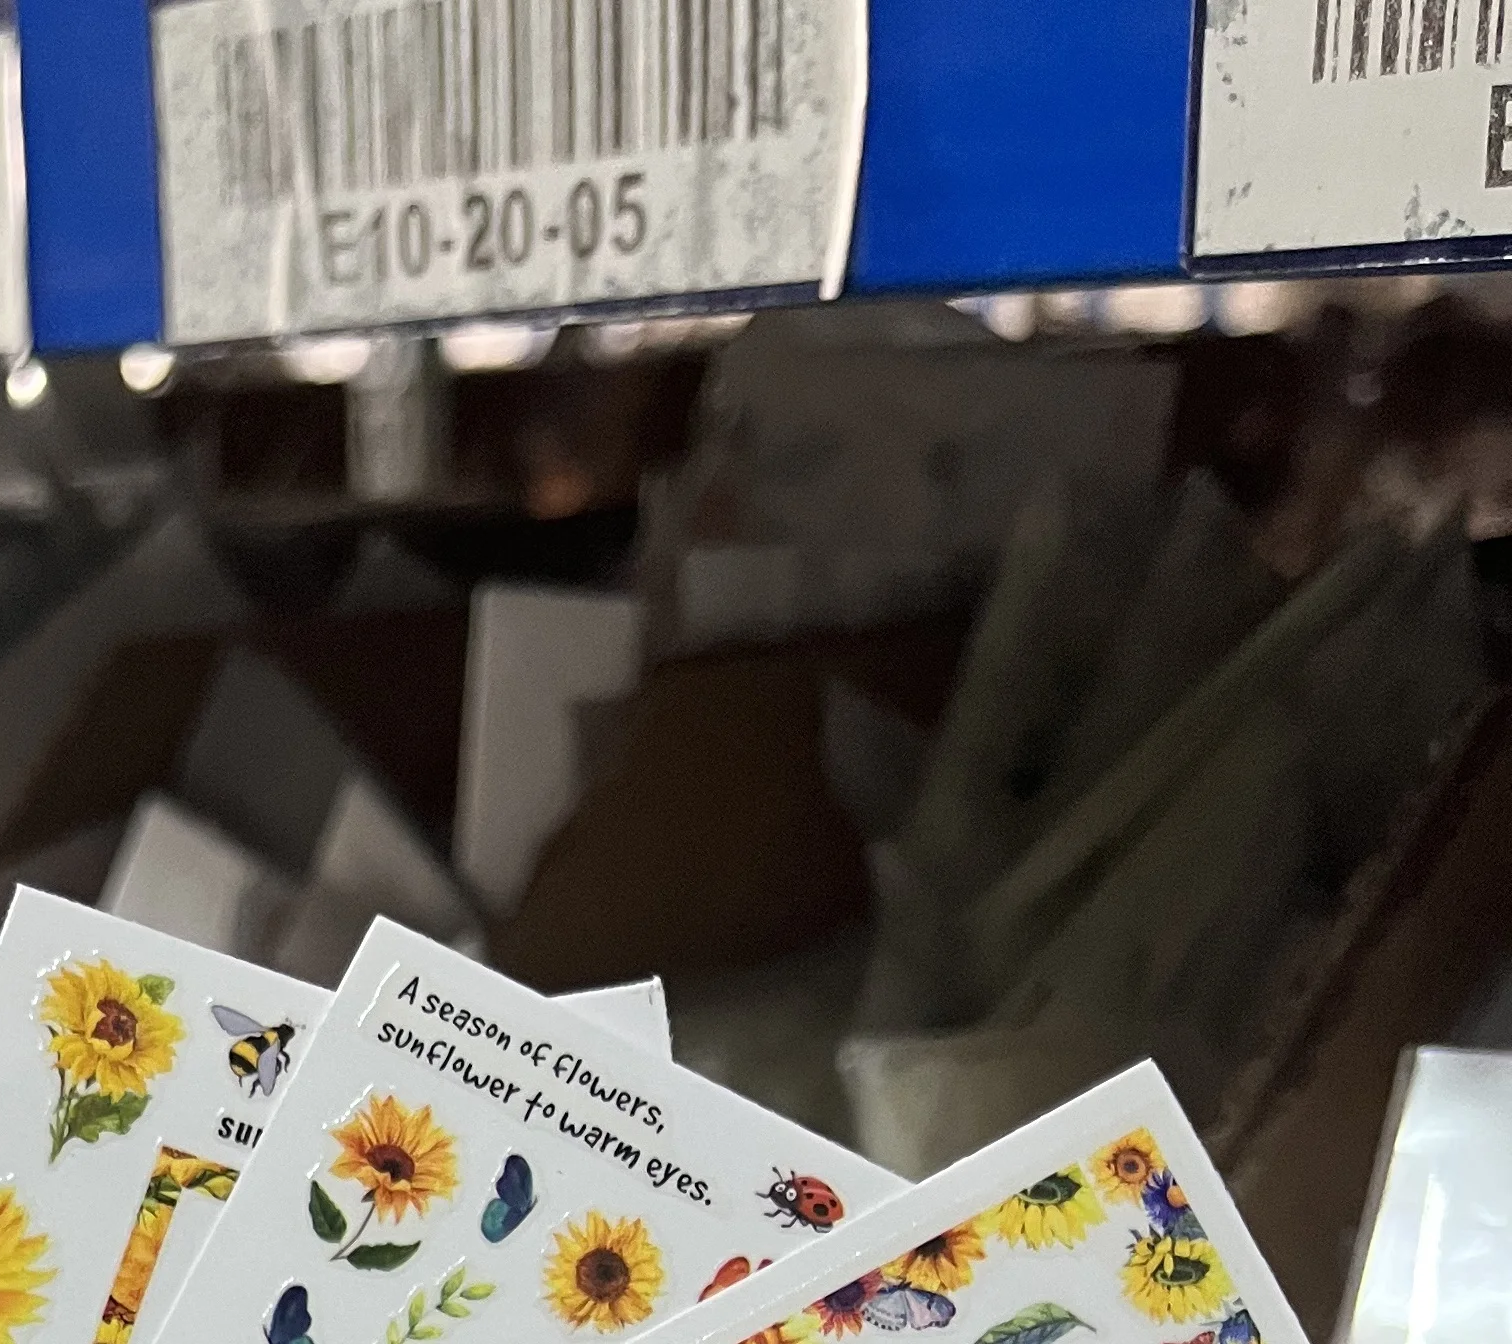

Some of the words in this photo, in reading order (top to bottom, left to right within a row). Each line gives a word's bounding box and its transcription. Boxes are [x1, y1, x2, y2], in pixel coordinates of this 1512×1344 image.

[320, 172, 647, 284] E10-20-05
[377, 1021, 521, 1104] sunflower
[524, 1091, 555, 1122] to
[559, 1112, 642, 1169] warm
[646, 1159, 713, 1206] eyes.
[397, 975, 421, 1001] A
[421, 993, 512, 1052] season
[520, 1040, 552, 1068] of
[552, 1053, 664, 1134] flowers,
